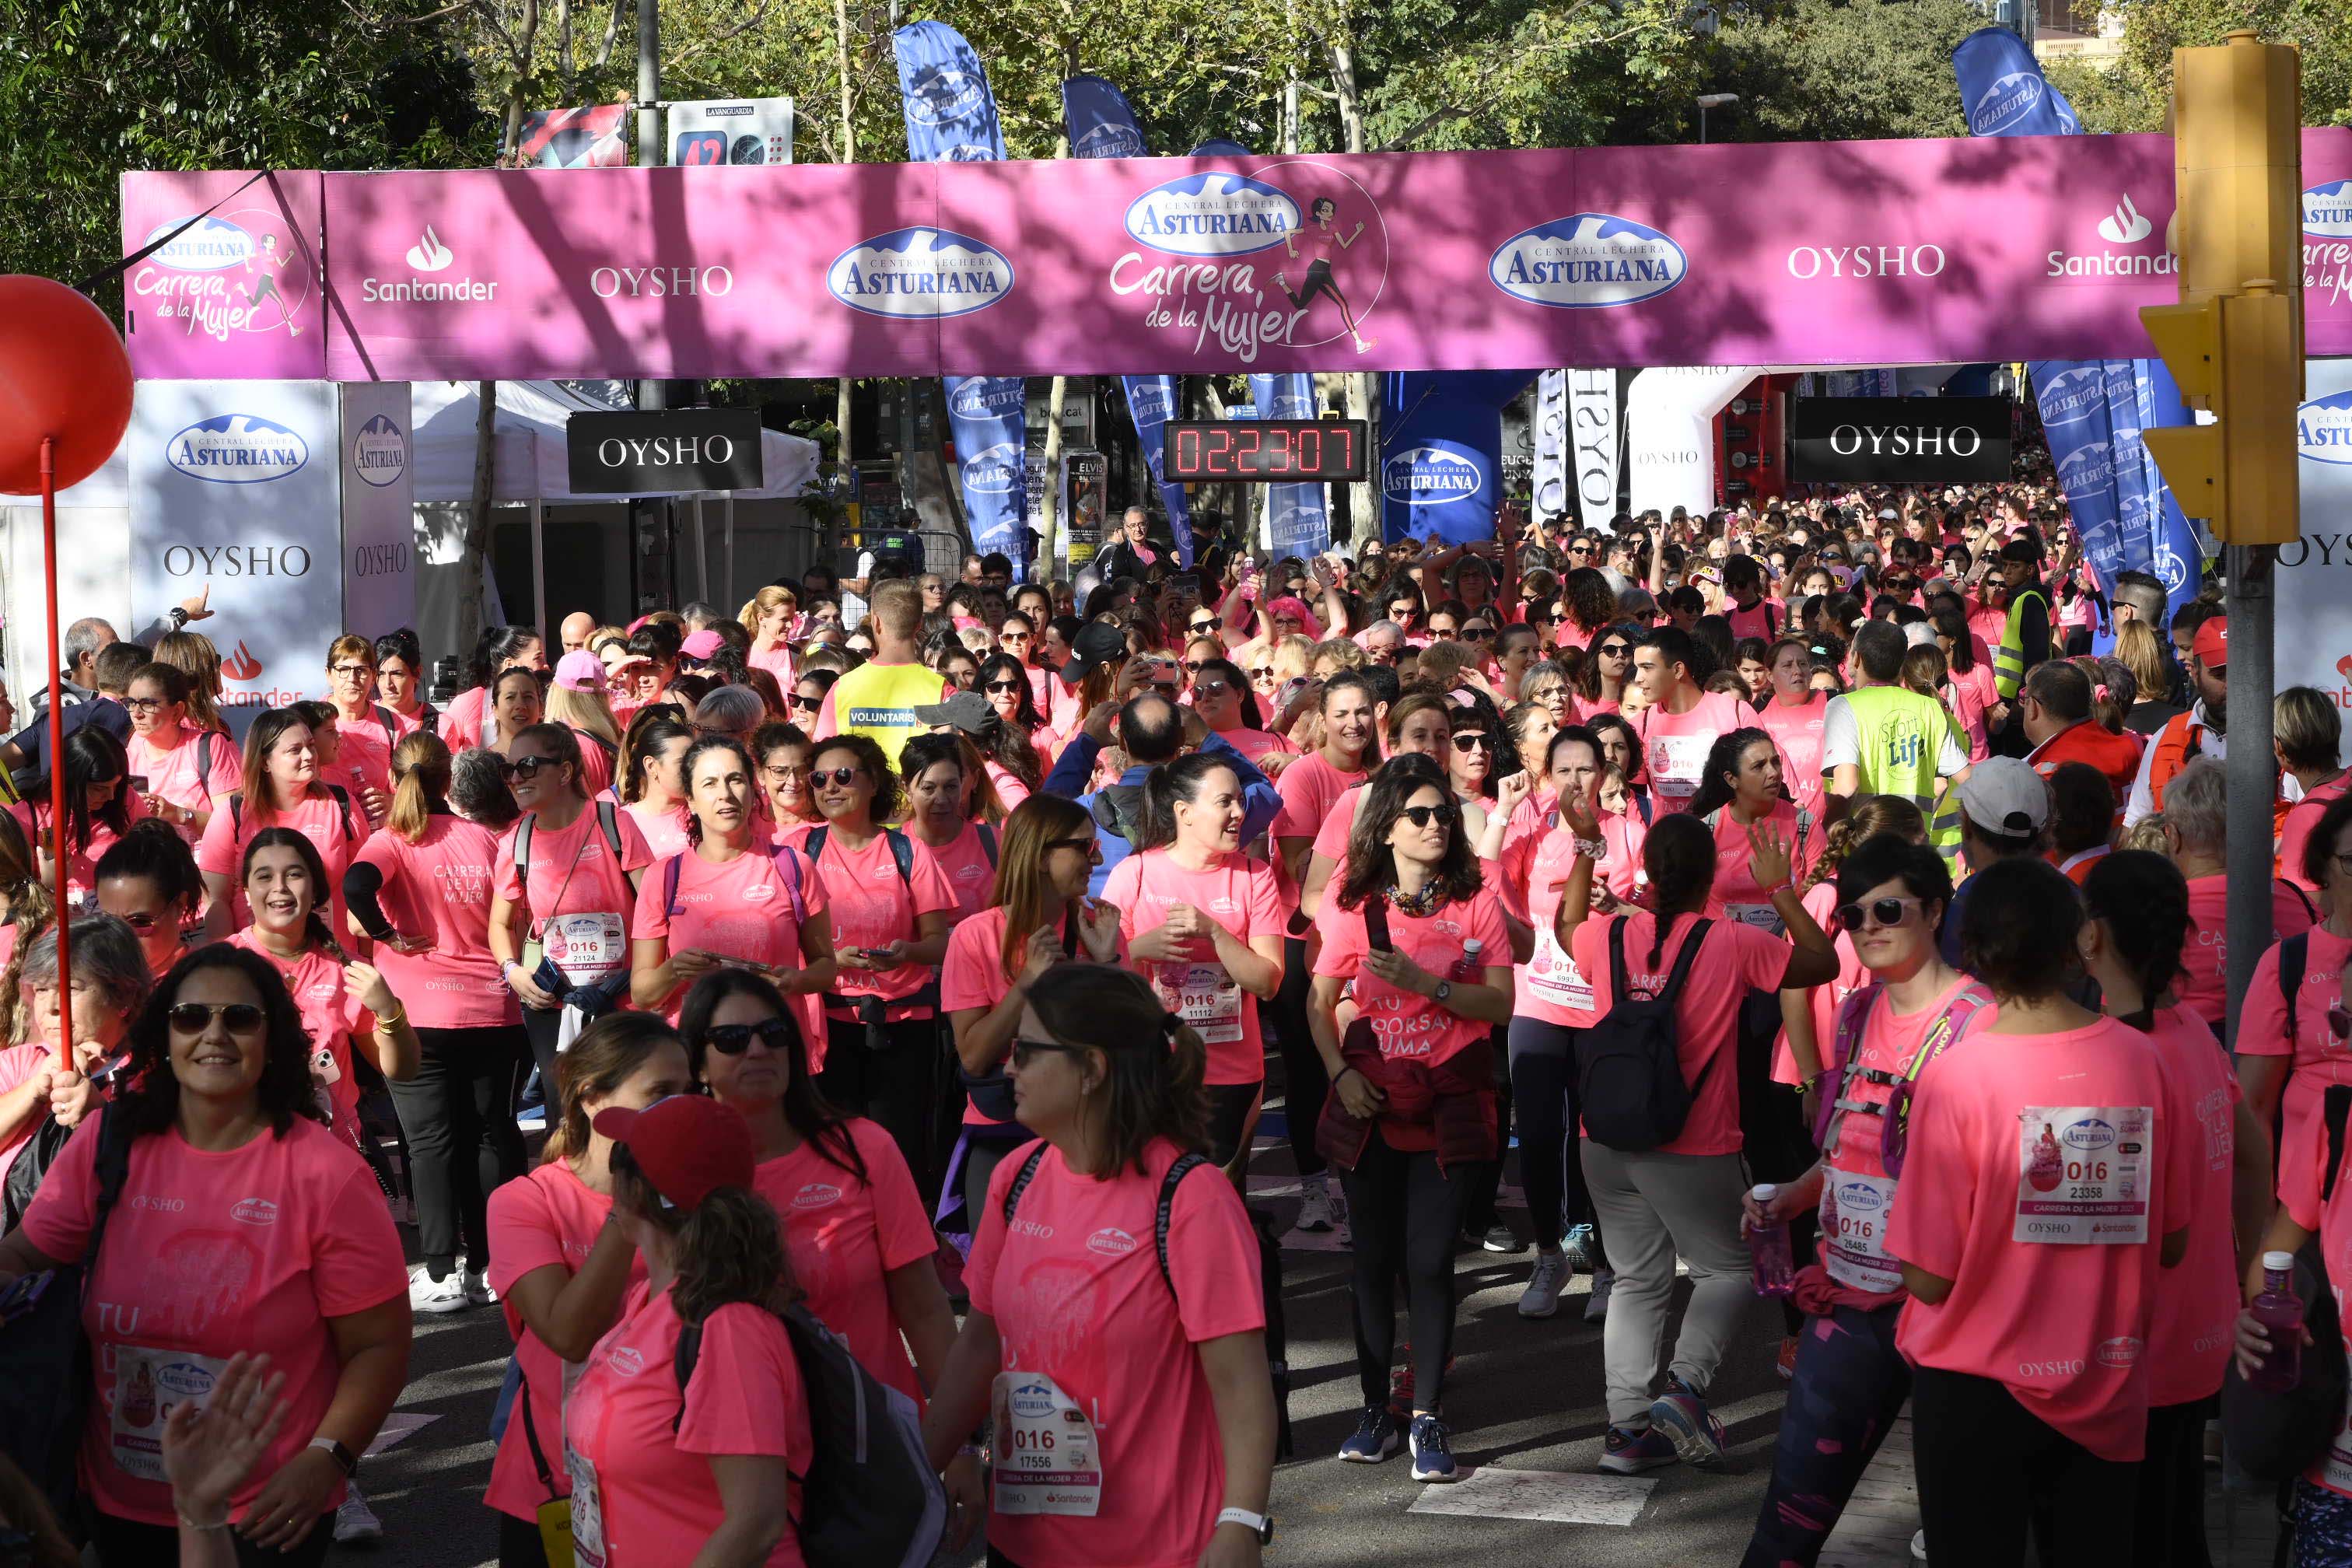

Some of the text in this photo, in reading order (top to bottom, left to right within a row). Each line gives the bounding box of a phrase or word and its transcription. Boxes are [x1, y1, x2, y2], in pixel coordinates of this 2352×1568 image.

[1165, 200, 1283, 210] CENTRAL LECHERA
[1139, 204, 1288, 235] ASTURIANA
[1535, 244, 1666, 256] CENTRAL LECHERA
[870, 257, 995, 268] CENTRAL LECHERA
[1504, 250, 1672, 285] ASTURIANA
[1787, 243, 1945, 279] OYSHO
[2047, 250, 2179, 277] Santande
[134, 267, 226, 296] Carrera
[590, 266, 733, 299] OYSHO
[841, 261, 1000, 295] ASTURIANA
[1109, 252, 1255, 297] Carrera
[362, 277, 498, 303] Santander
[156, 294, 261, 342] de la Mujer
[1145, 289, 1311, 363] de la Mujer
[599, 435, 733, 467] OYSHO
[1178, 429, 1351, 473] 02:23:07
[1830, 425, 1981, 457] OYSHO
[177, 439, 299, 467] ASTURIANA
[357, 445, 404, 470] ASTURIANA
[1639, 451, 1699, 465] OYSHO
[1079, 463, 1104, 472] ELVIS
[1386, 471, 1474, 492] ASTURIANA
[163, 545, 311, 577] OYSHO
[355, 542, 406, 578] OYSHO
[1881, 715, 1920, 743] Sport
[1888, 734, 1927, 768] Life
[434, 865, 493, 878] CARRERA
[447, 878, 481, 891] DE LA
[444, 892, 484, 903] MUJER
[570, 941, 598, 952] 016
[1554, 961, 1580, 975] 016
[425, 982, 464, 992] OYSHO
[1557, 975, 1574, 984] 6993
[1185, 995, 1215, 1006] 016
[1372, 996, 1401, 1011] TU
[1378, 1034, 1431, 1055] UMA
[2067, 1130, 2112, 1143] ASTURIANA
[2067, 1161, 2109, 1181] 016
[1840, 1191, 1879, 1206] ASTURIANA
[2070, 1187, 2103, 1199] 23358
[1840, 1217, 1873, 1237] 016
[2028, 1222, 2137, 1234] OYSHO Santander
[97, 1302, 139, 1335] TU
[2018, 1360, 2085, 1377] OYSHO
[160, 1371, 211, 1389] ASTURIANA
[1014, 1430, 1055, 1450] 016
[1020, 1455, 1052, 1468] 17556
[1055, 1493, 1094, 1503] Santander
